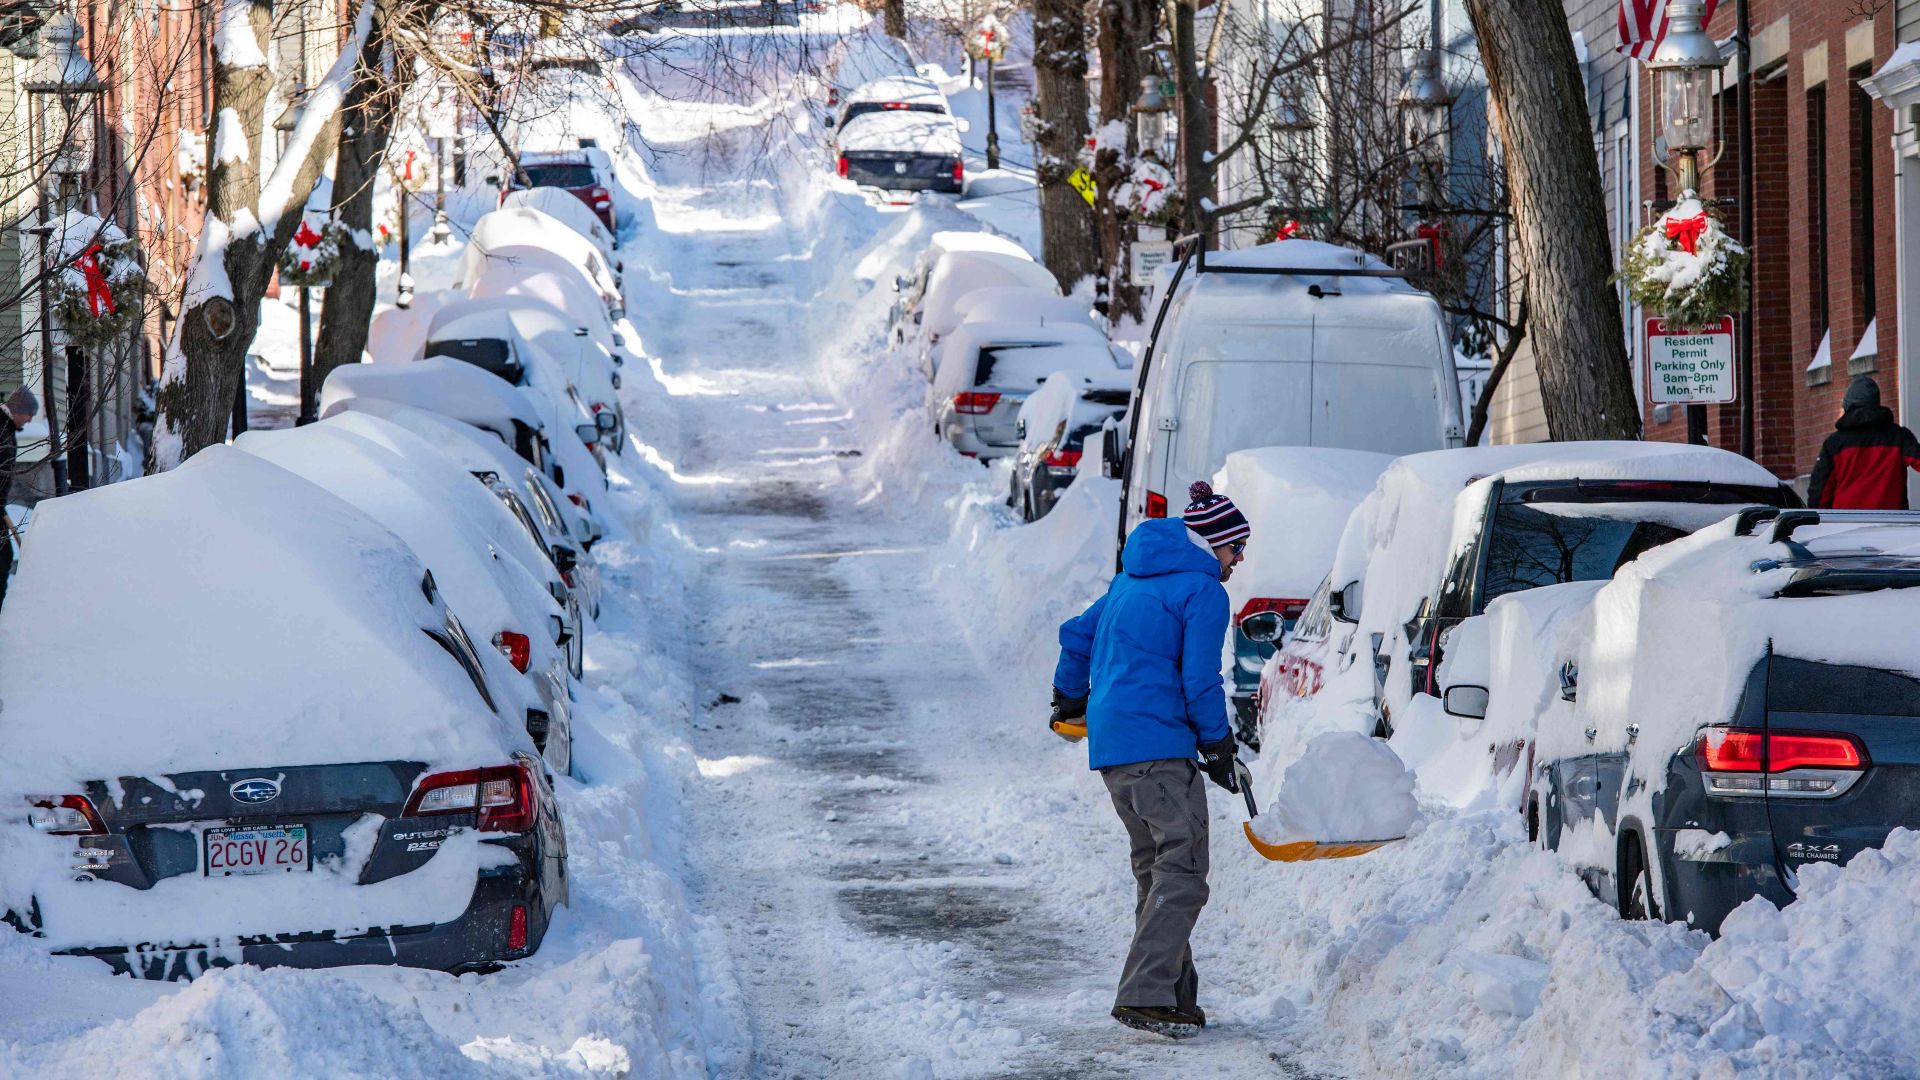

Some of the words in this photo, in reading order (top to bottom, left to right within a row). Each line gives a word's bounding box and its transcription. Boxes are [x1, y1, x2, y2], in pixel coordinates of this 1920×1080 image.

[1664, 336, 1714, 346] Resident
[1671, 348, 1707, 358] Permit
[1654, 361, 1695, 372] Parking
[1700, 360, 1725, 370] Only
[1663, 373, 1718, 383] 8am-8pm
[1666, 384, 1716, 395] Mon.-Fri.
[228, 831, 287, 840] Massausetts
[292, 829, 303, 837] 22
[210, 840, 267, 868] 2CGV
[275, 839, 303, 864] 26
